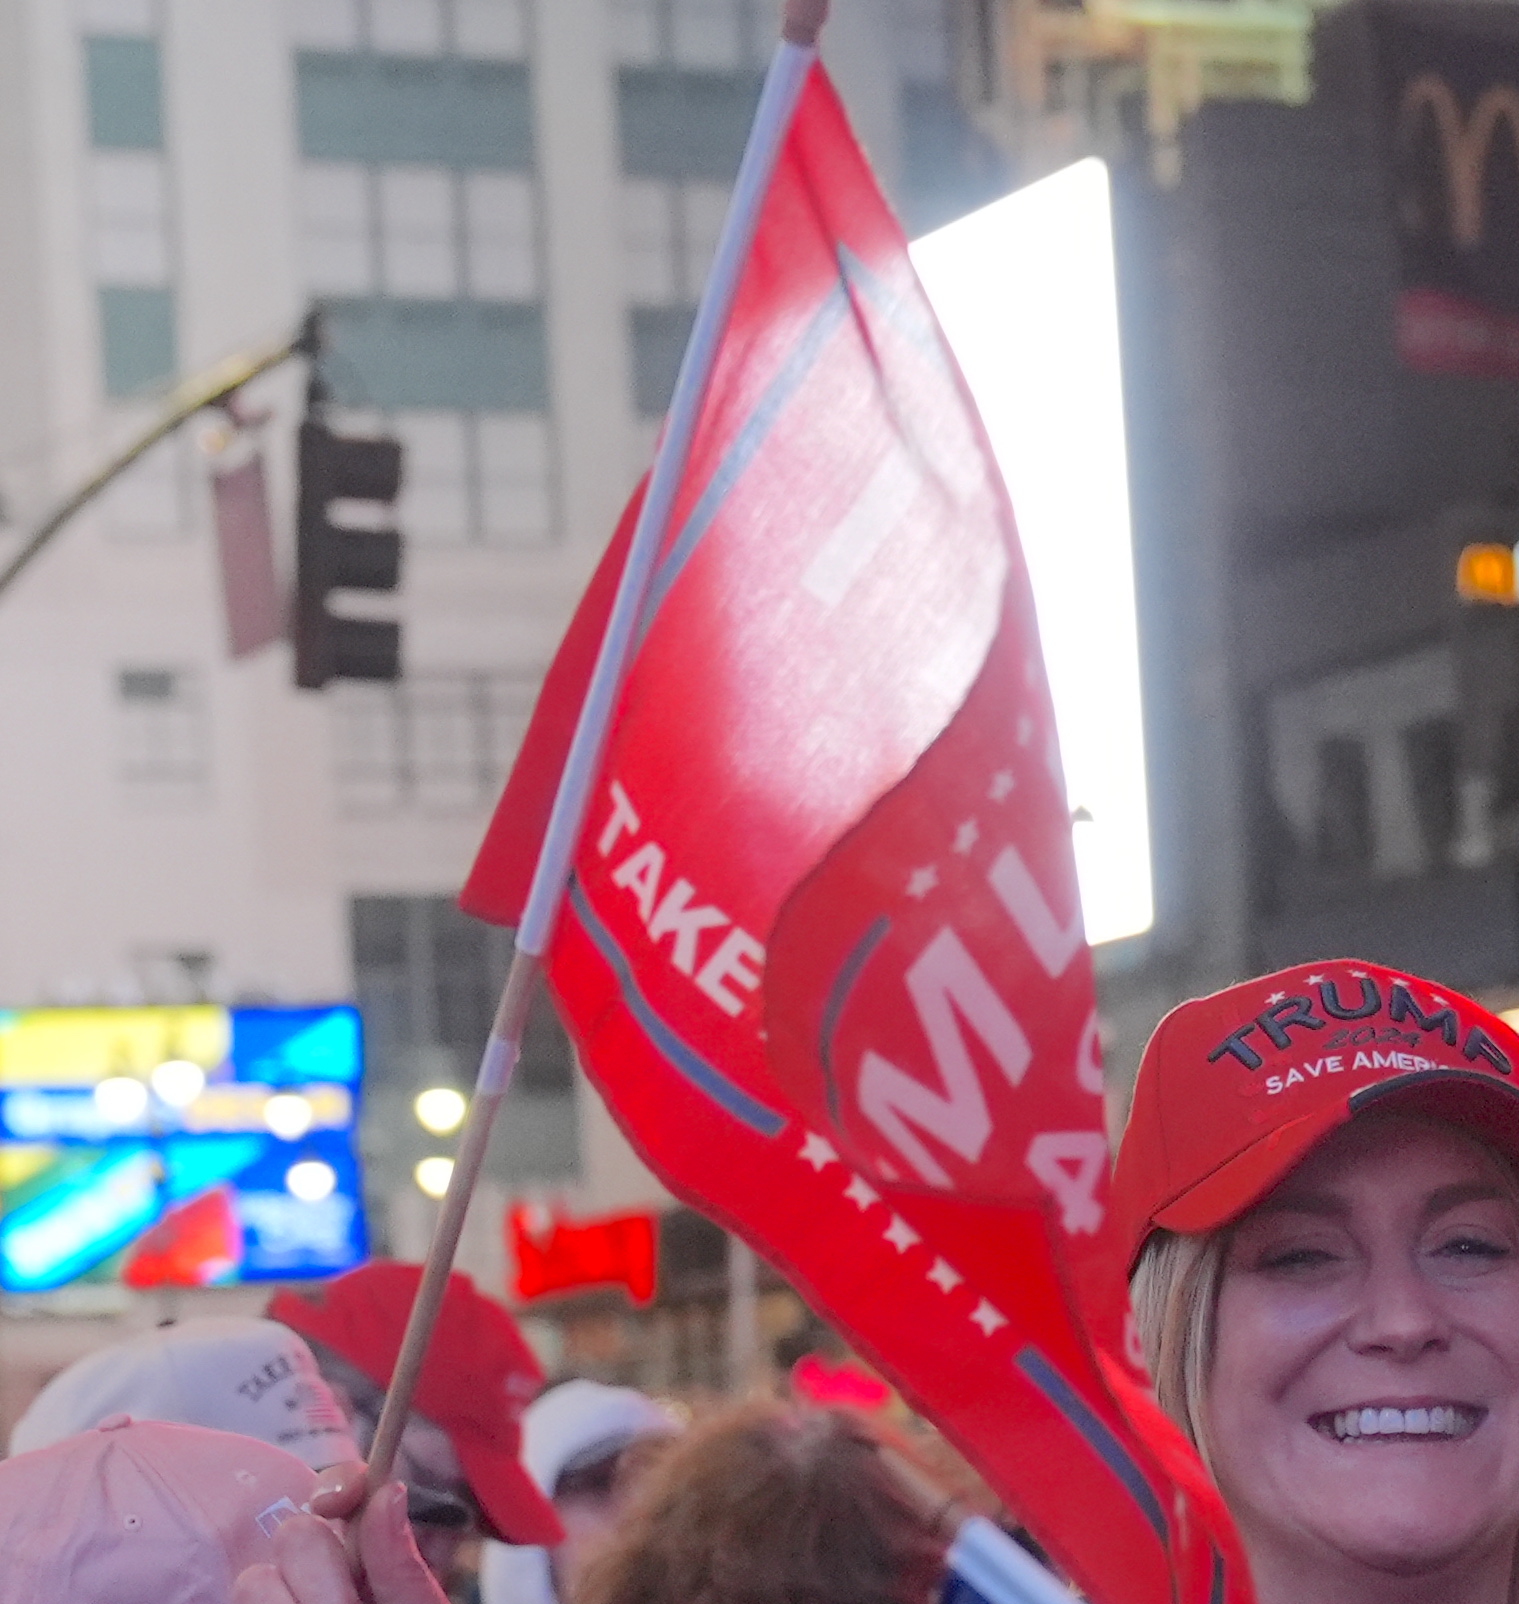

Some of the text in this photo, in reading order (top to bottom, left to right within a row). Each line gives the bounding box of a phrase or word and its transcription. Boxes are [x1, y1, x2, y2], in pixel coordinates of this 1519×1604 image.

[597, 781, 766, 1017] TAKE
[1208, 977, 1512, 1075] TRUMP
[1324, 1026, 1422, 1049] 2024
[1265, 1056, 1344, 1095] SAVE
